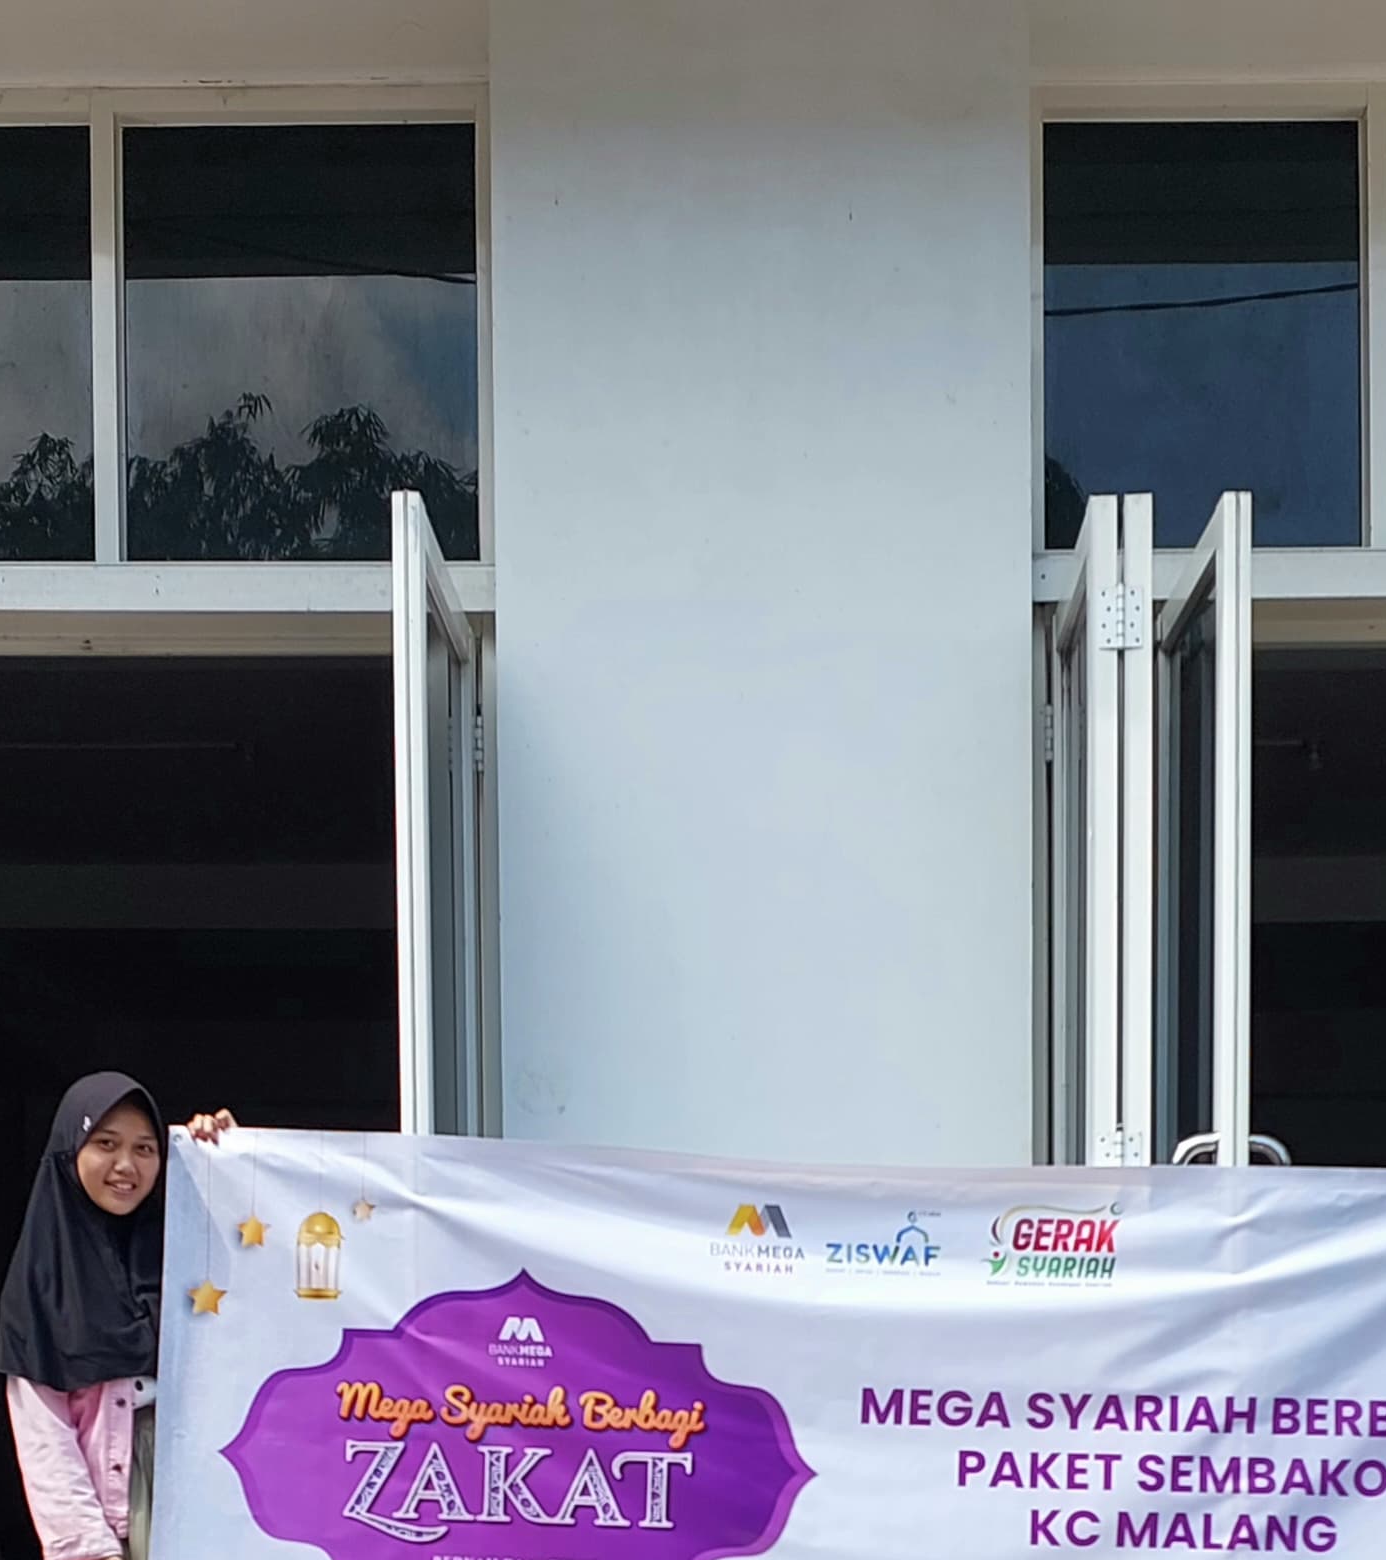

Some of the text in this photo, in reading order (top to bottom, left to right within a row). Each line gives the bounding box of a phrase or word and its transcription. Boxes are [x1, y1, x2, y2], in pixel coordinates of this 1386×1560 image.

[825, 1243, 941, 1266] ZISWAF
[1012, 1218, 1120, 1253] GERAK
[724, 1261, 793, 1274] SYARIAH
[1016, 1256, 1116, 1279] SYARIAH
[336, 1381, 705, 1450] Mega Syariah Berbagi
[861, 1388, 1011, 1428] MEGA
[1026, 1392, 1257, 1434] SYARIAH
[957, 1450, 1122, 1491] PAKET
[342, 1440, 693, 1543] ZAKAT
[1029, 1509, 1338, 1552] KC MALANG
